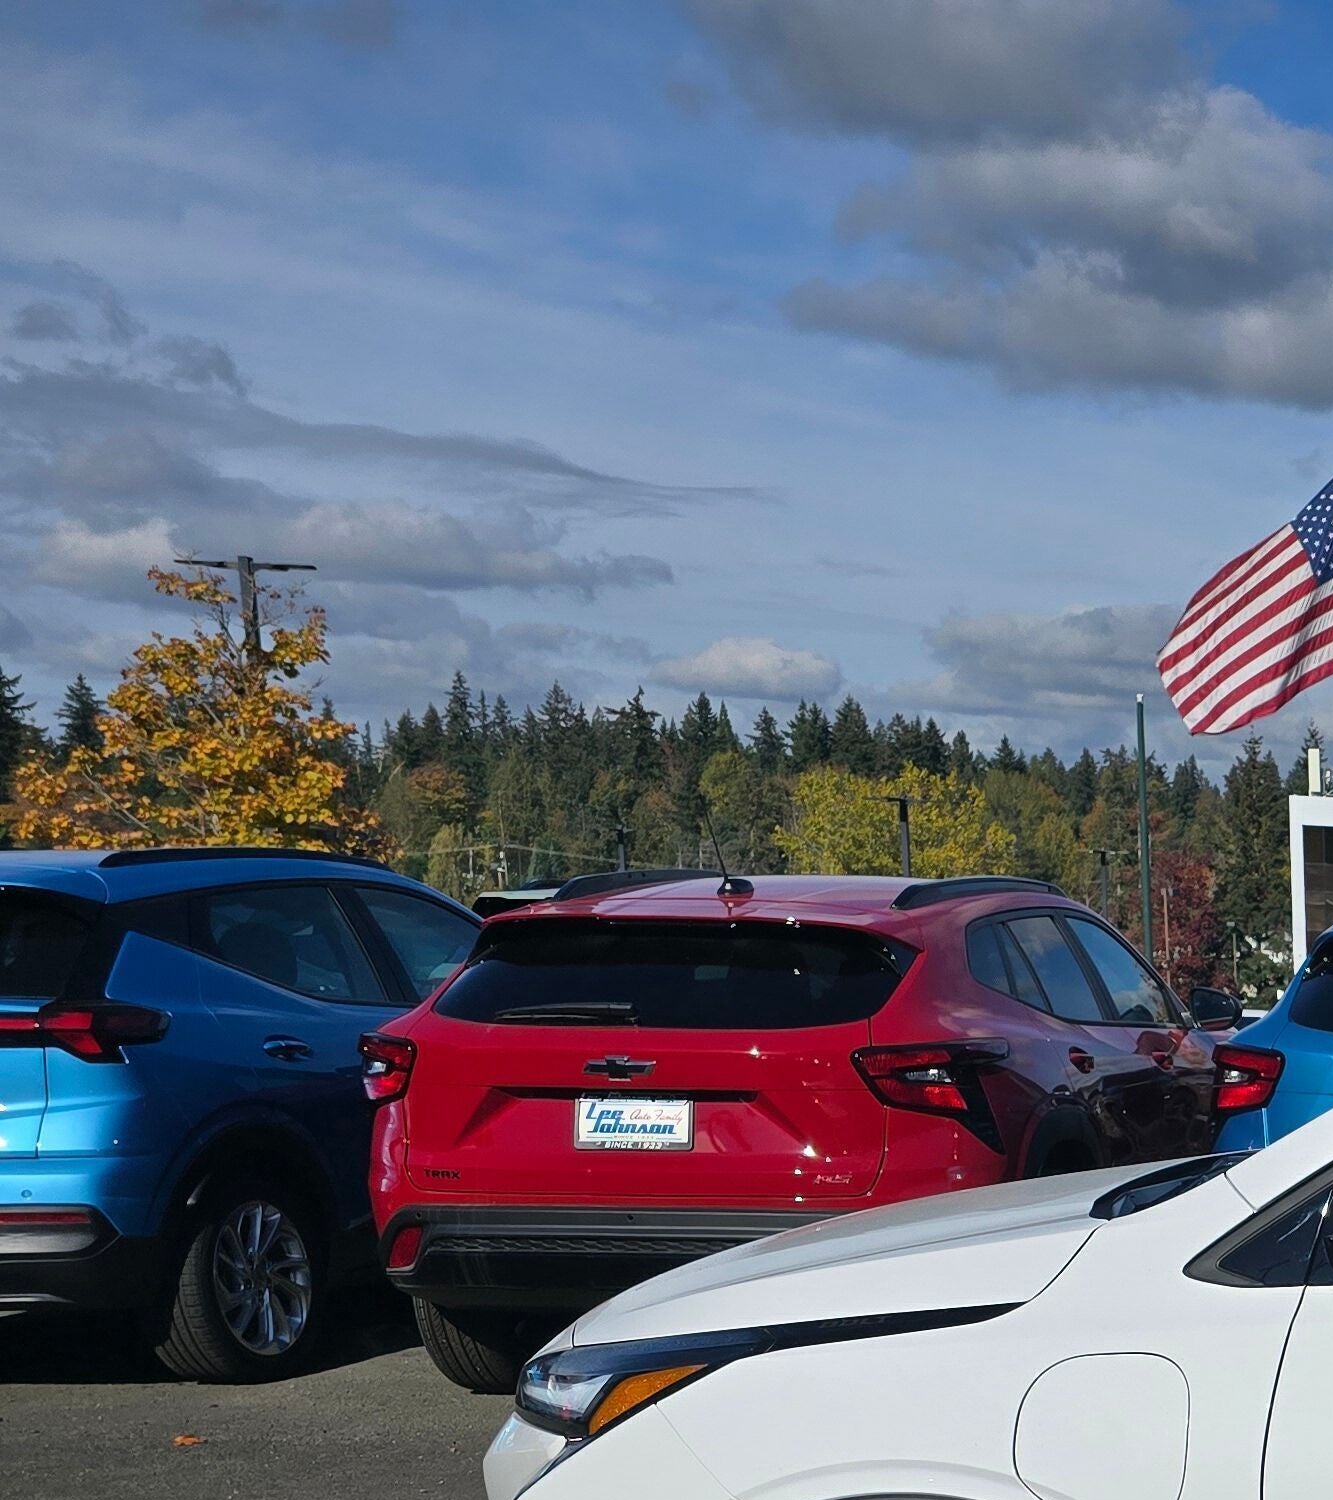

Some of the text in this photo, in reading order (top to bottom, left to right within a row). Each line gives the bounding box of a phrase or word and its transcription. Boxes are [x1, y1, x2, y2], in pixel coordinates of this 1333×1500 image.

[585, 1101, 625, 1120] Lee
[629, 1108, 683, 1126] Auto Family
[586, 1117, 678, 1135] Johnson
[604, 1141, 633, 1149] SINCE
[423, 1168, 461, 1180] TRAX
